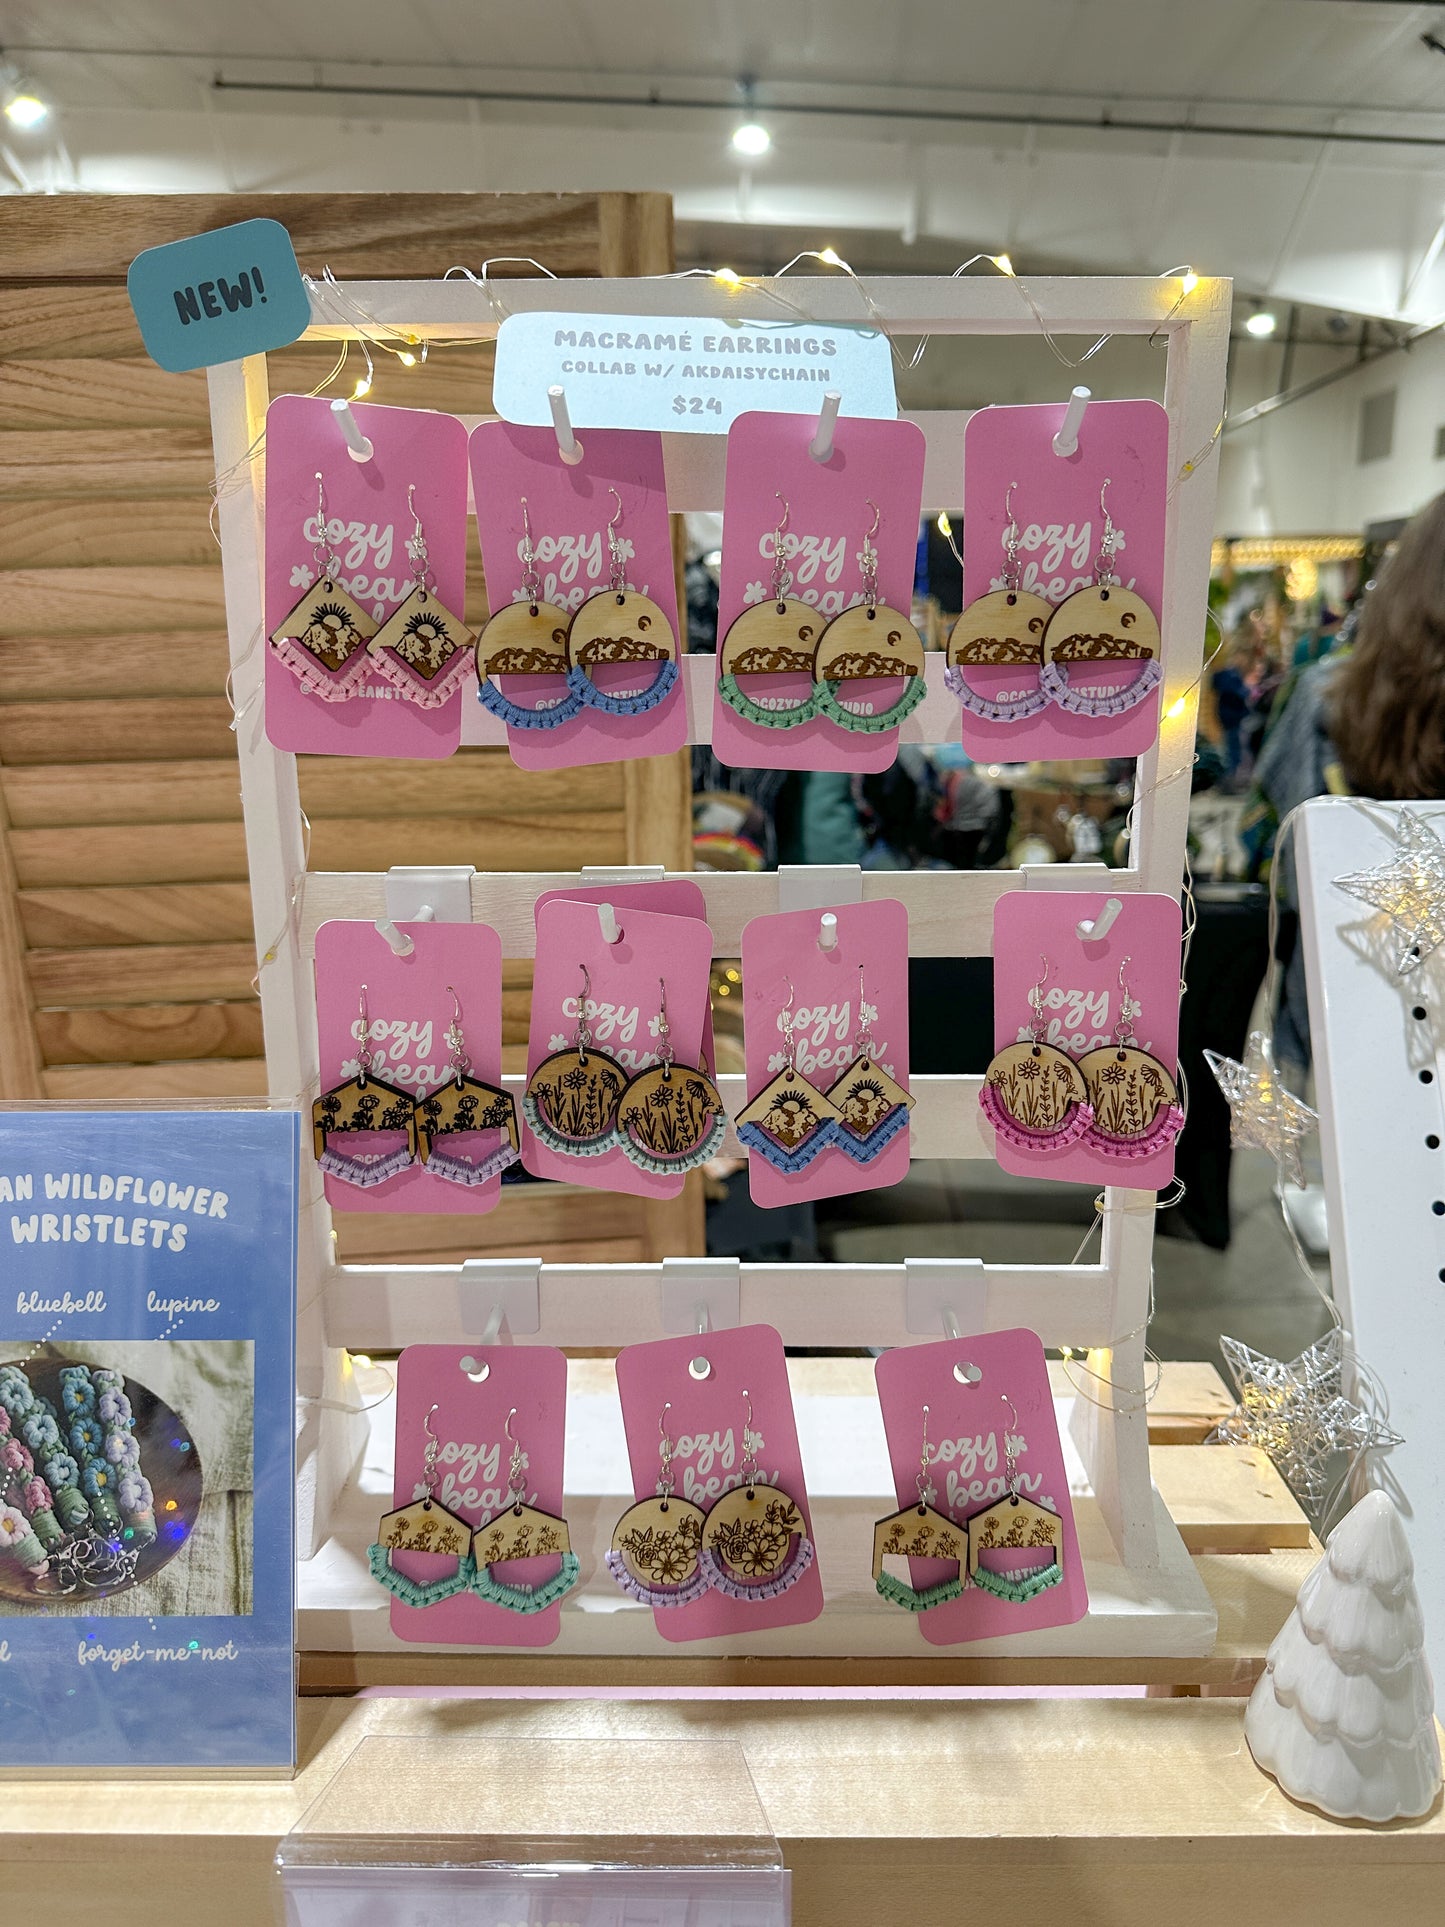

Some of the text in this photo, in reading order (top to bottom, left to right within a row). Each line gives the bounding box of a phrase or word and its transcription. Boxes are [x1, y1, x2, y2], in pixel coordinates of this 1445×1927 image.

[173, 266, 268, 326] NEW!
[554, 329, 837, 357] MACRAMÉ EARRINGS
[561, 360, 831, 382] COLLAB W/ AKDAISYCHAIN
[671, 394, 722, 416] $24
[303, 517, 394, 570] cozy
[758, 532, 847, 584] cozy
[351, 1019, 433, 1060] cozy
[562, 997, 639, 1042] cozy
[45, 1173, 229, 1220] WILDFLOWER
[11, 1213, 188, 1253] WRISTLETS
[17, 1290, 221, 1322] bluebell lupine
[945, 1470, 1043, 1508] bean
[78, 1640, 240, 1672] forget-me-not
